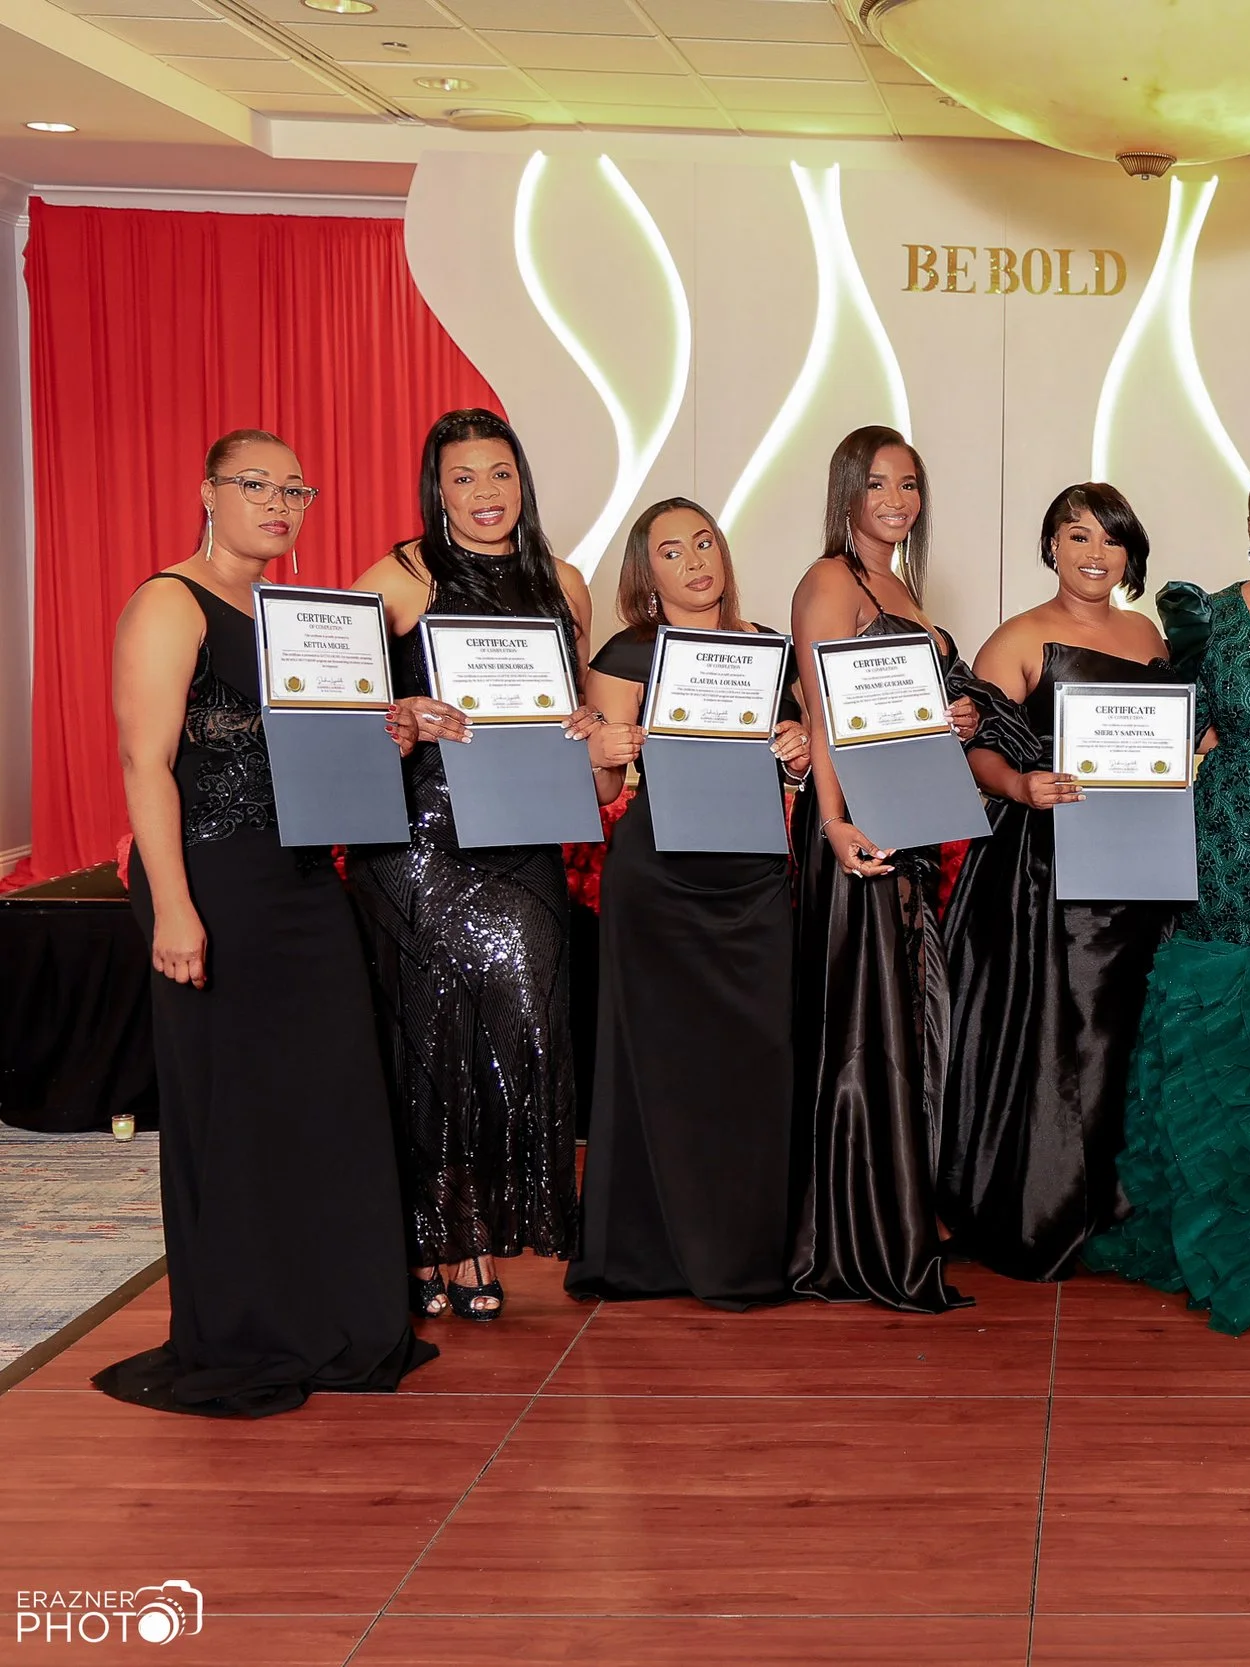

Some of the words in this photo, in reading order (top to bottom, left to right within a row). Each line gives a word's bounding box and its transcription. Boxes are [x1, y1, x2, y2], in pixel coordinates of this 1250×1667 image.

[902, 244, 977, 293] BE
[983, 248, 1127, 296] BOLD
[297, 613, 352, 625] CERTIFICATE
[328, 642, 350, 650] MICHEL
[466, 638, 528, 648] CERTIFICATE
[696, 653, 753, 664] CERTIFICATE
[853, 656, 907, 668] CERTIFICATE
[690, 677, 718, 685] CLAUDIA
[1095, 706, 1156, 715] CERTIFICATE
